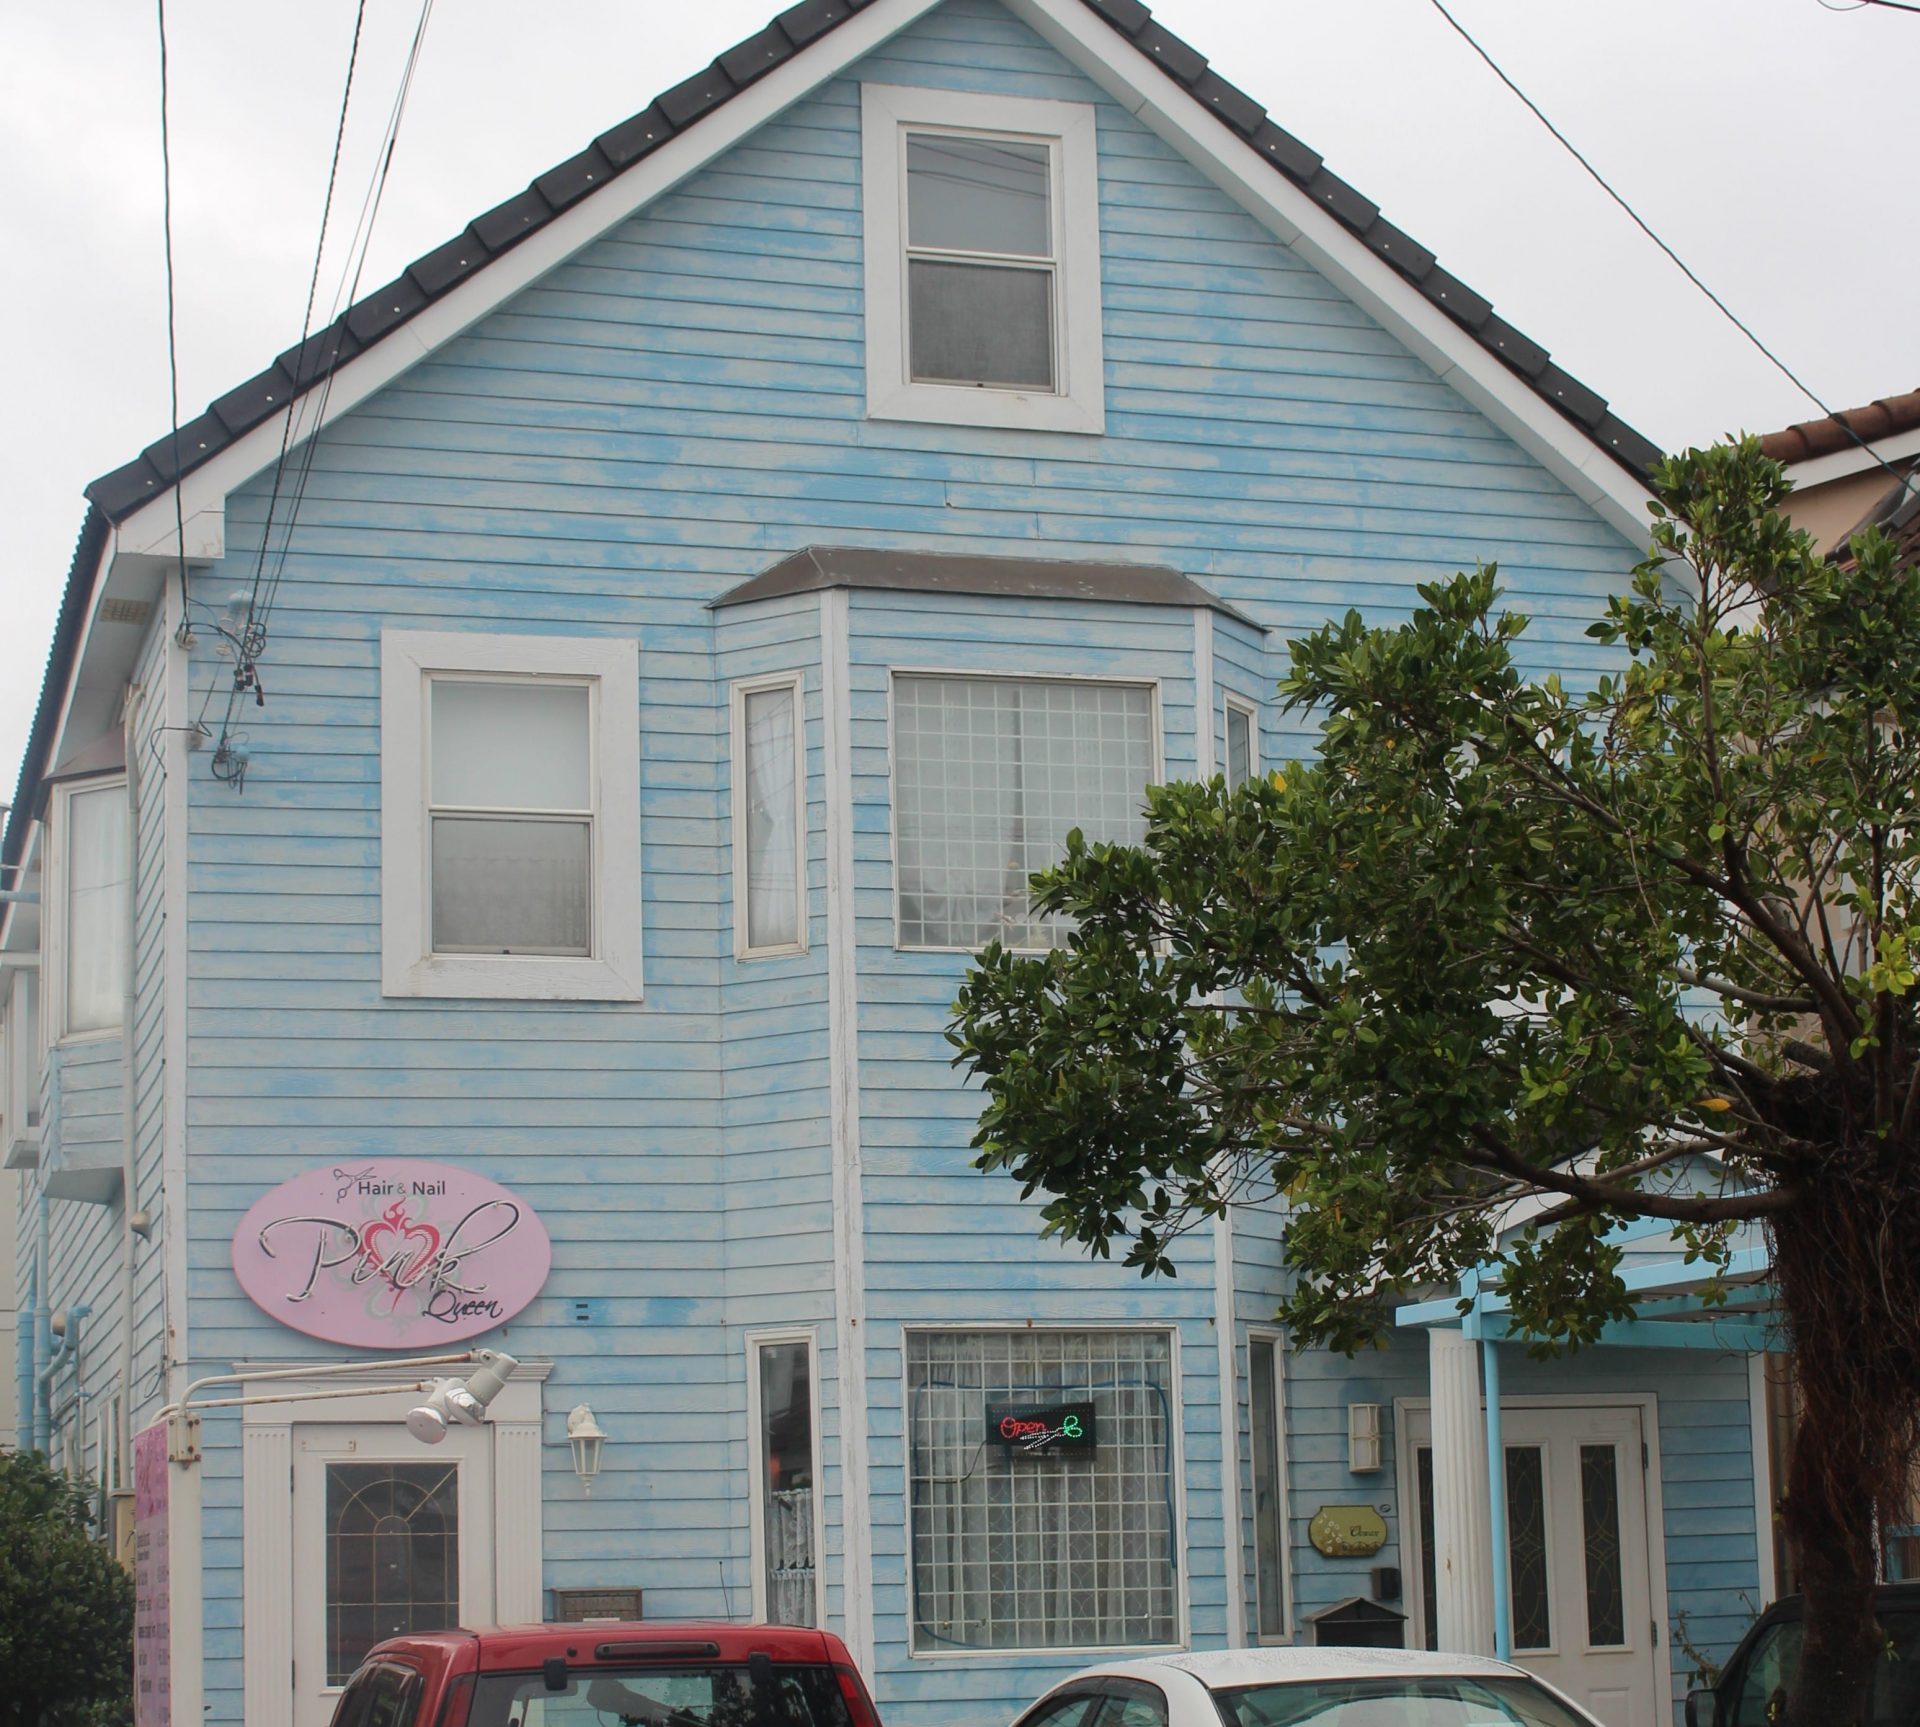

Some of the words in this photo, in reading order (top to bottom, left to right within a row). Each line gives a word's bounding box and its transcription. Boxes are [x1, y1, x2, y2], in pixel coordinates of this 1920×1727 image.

[358, 1181, 394, 1195] Hair
[397, 1182, 407, 1195] &
[413, 1181, 446, 1195] Nail
[259, 1199, 520, 1302] Pink
[422, 1290, 503, 1323] Queen
[1000, 1416, 1047, 1438] Open
